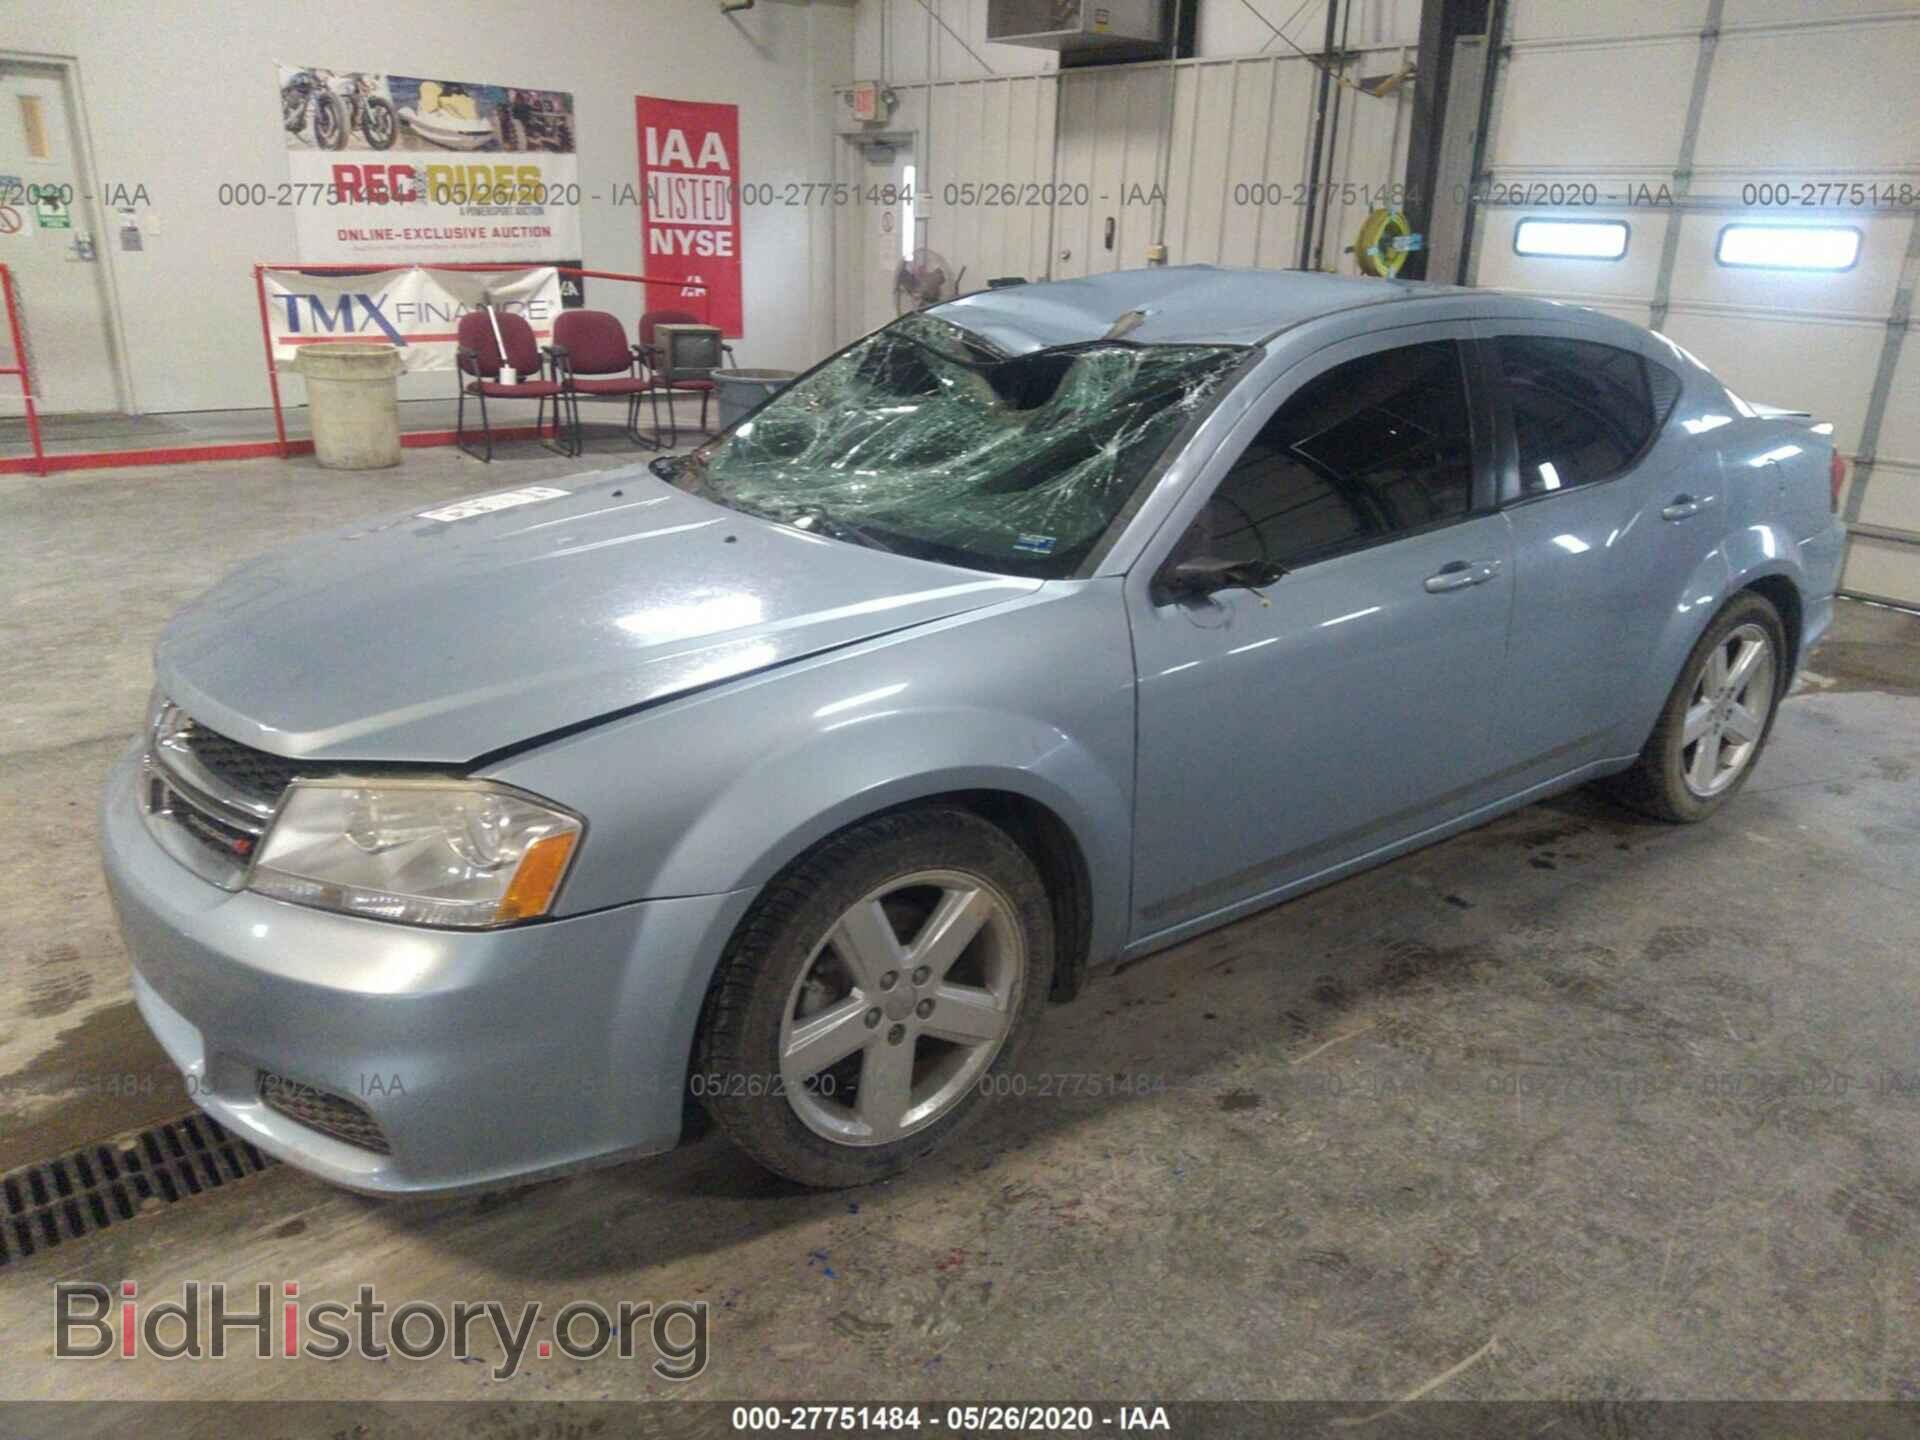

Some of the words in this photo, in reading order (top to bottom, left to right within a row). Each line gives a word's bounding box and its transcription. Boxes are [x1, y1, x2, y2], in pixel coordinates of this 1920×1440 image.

[645, 127, 730, 171] IAA
[332, 164, 417, 204] REC
[425, 164, 543, 203] RIDES
[653, 177, 728, 221] LISTED
[337, 228, 487, 241] ONLINE-EXCLUSIVE
[492, 226, 552, 239] AUCTION
[650, 229, 733, 257] NYSE
[272, 293, 408, 347] TMX
